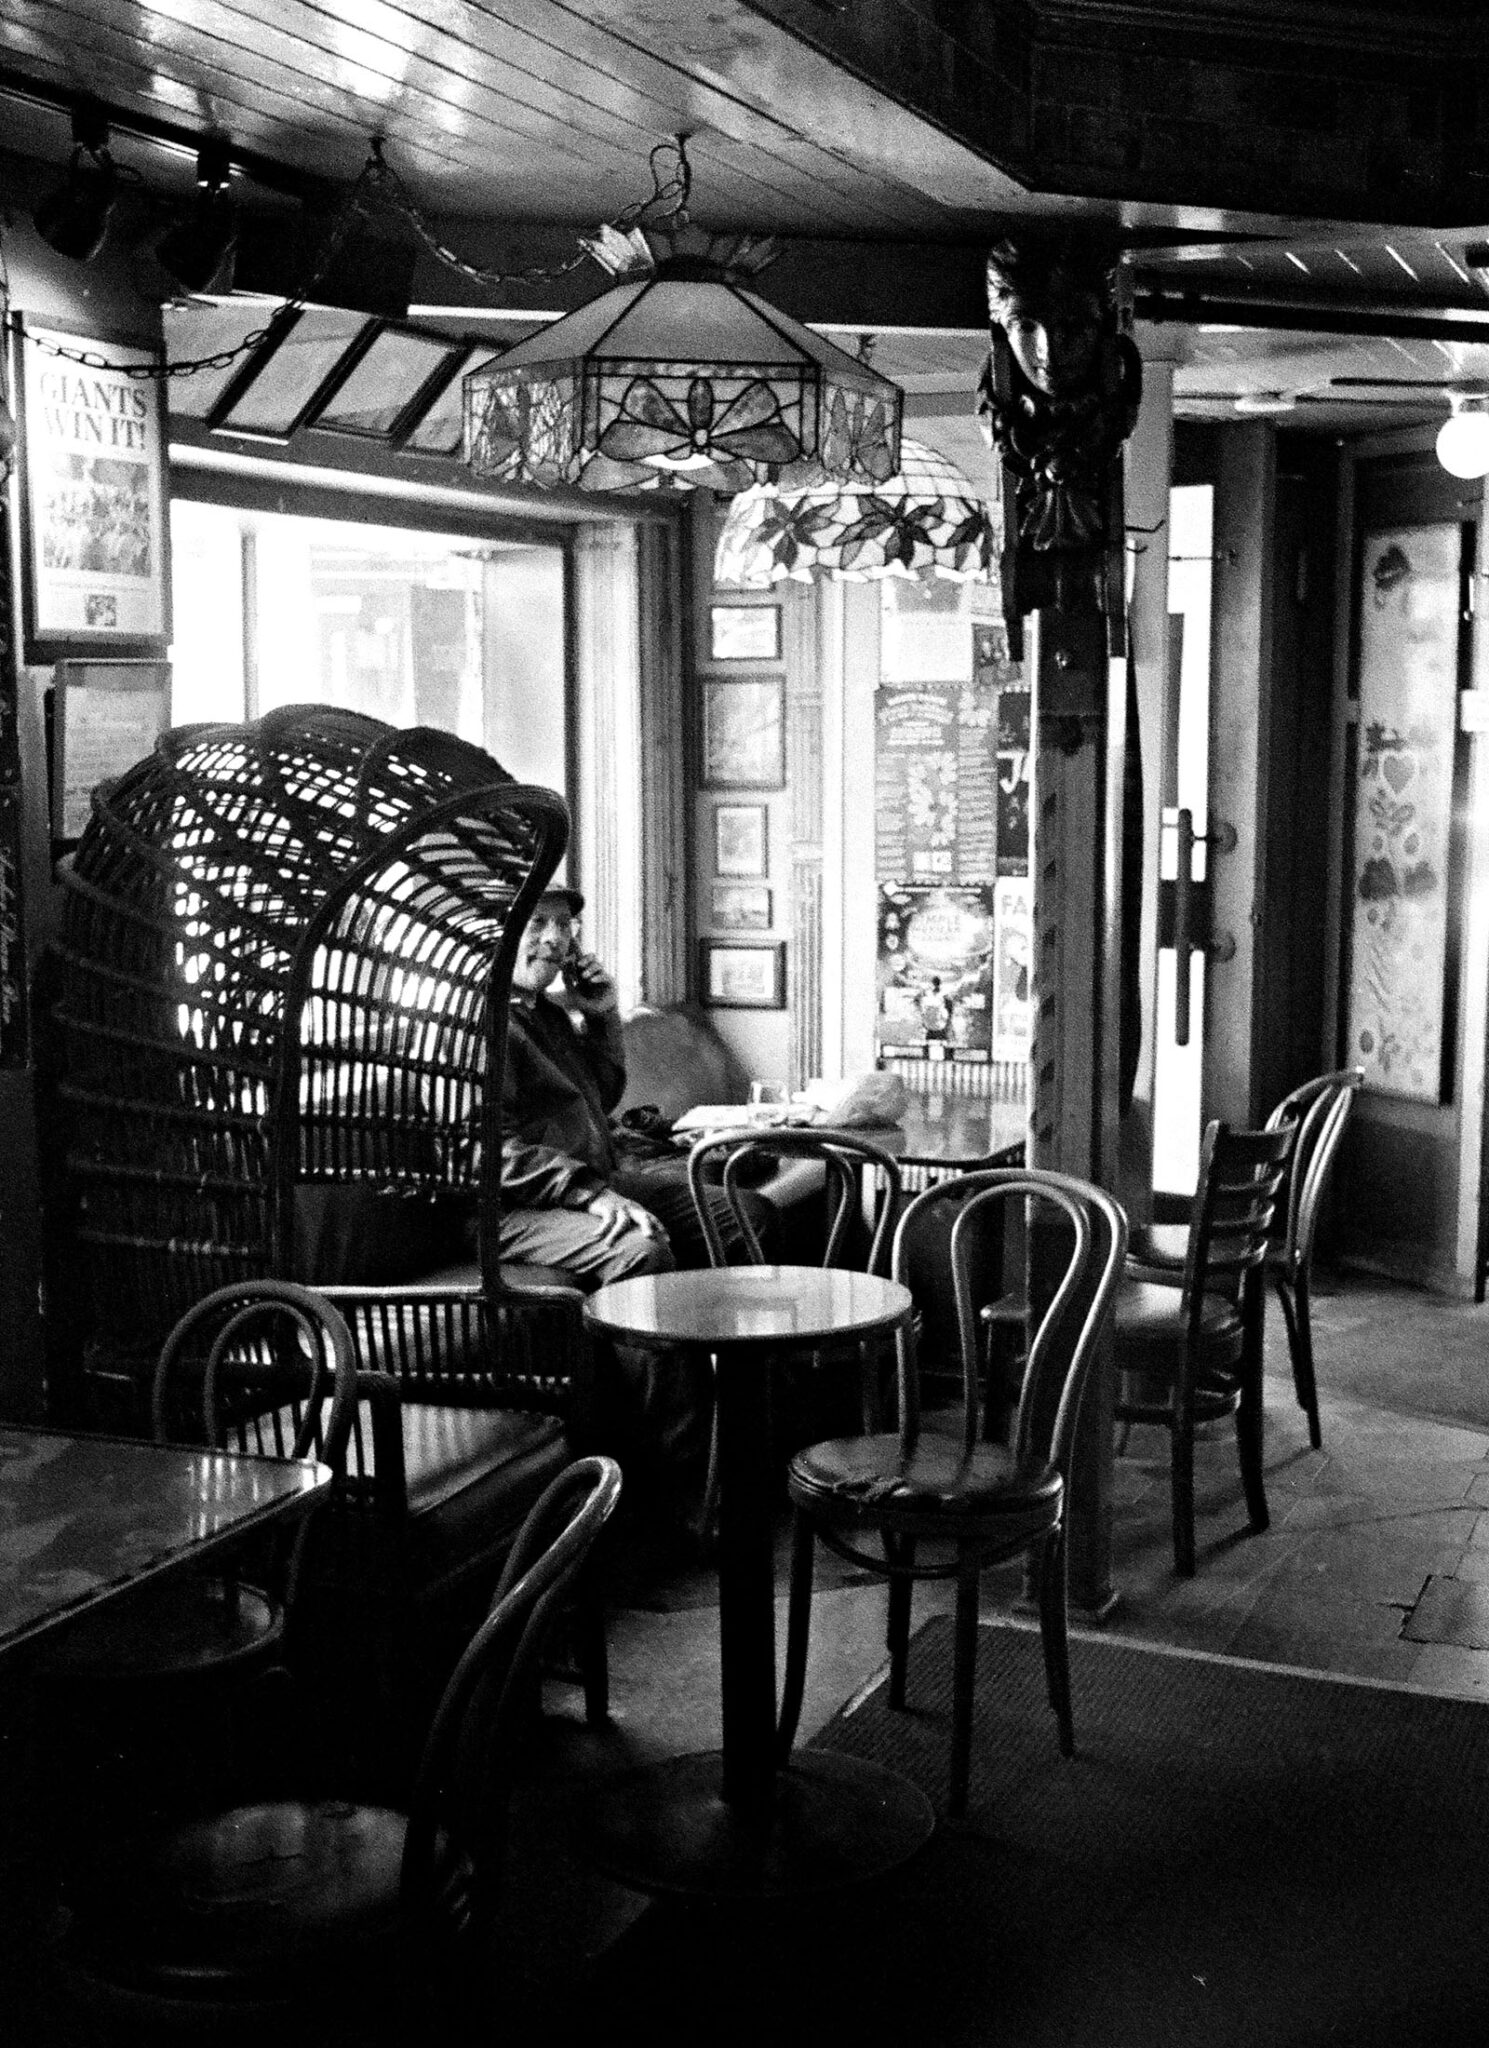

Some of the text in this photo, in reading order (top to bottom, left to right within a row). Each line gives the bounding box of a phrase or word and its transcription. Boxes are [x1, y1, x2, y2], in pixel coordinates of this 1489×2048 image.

[39, 370, 148, 419] GIANTS
[43, 406, 147, 451] WIN IT!
